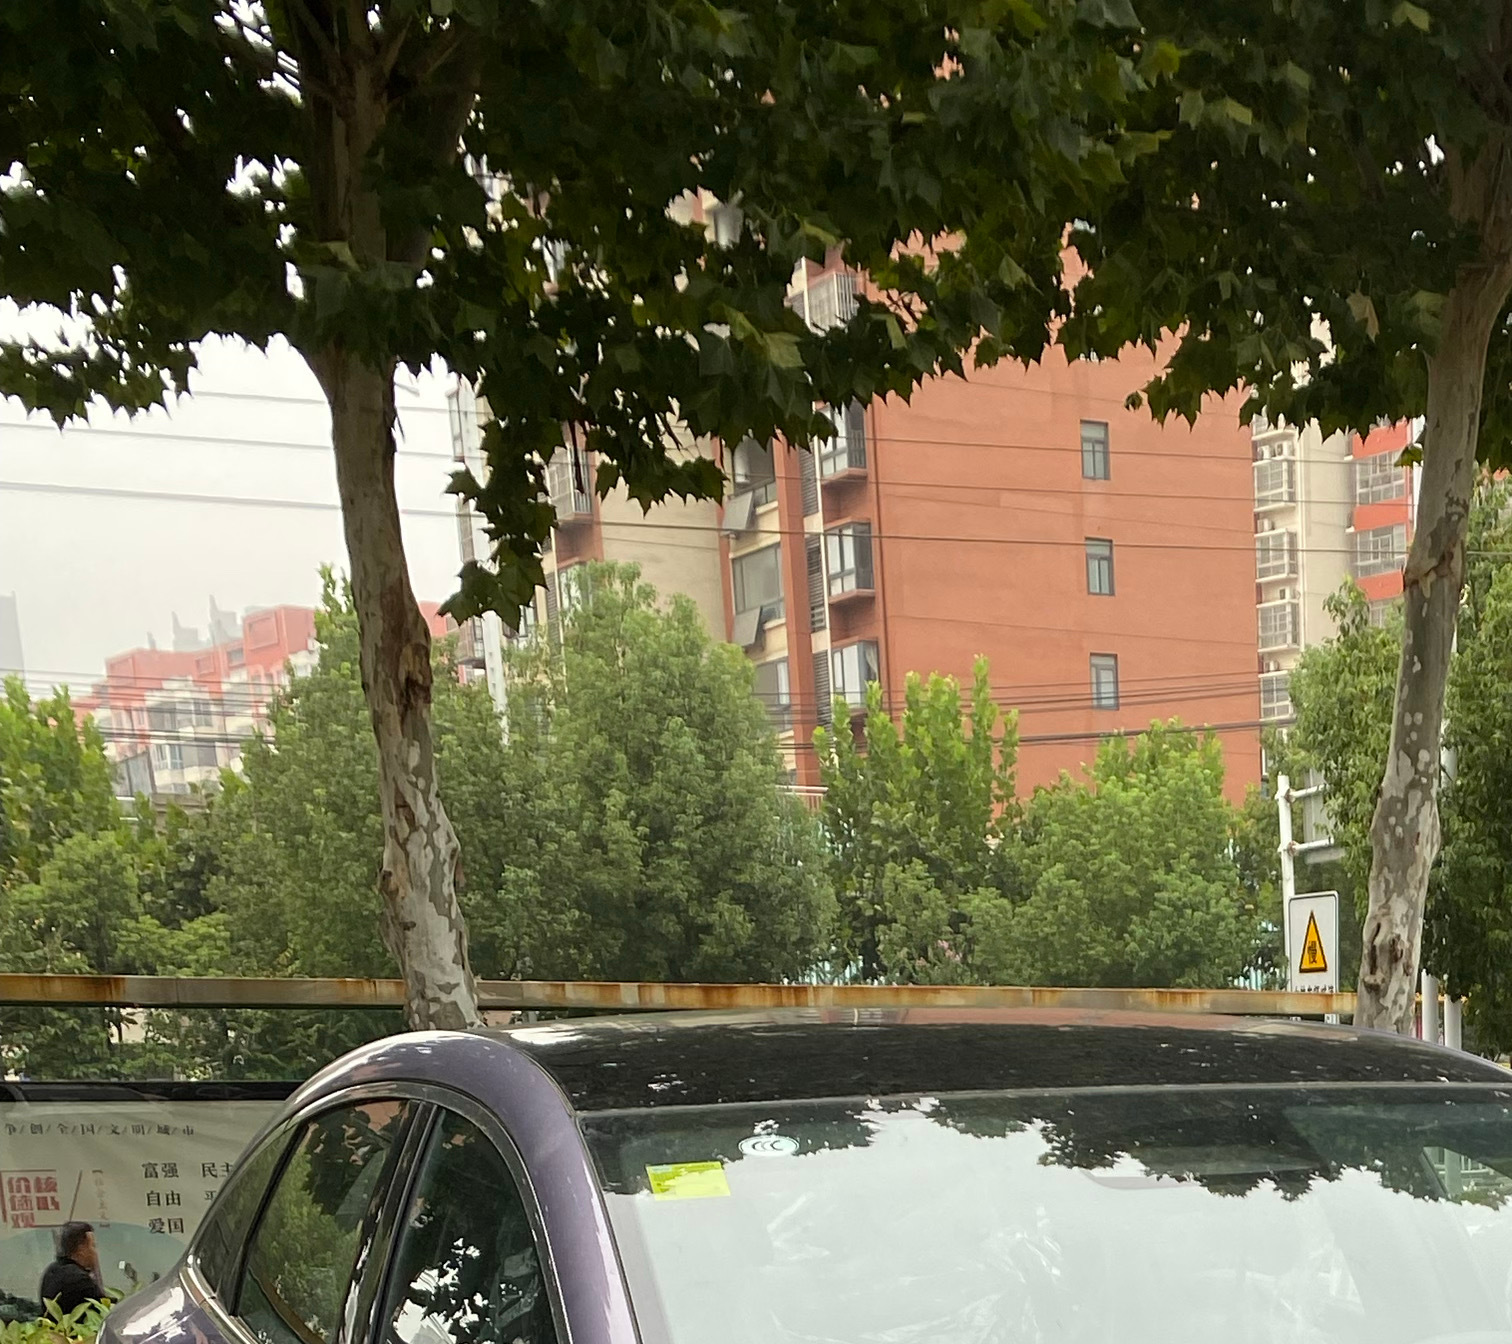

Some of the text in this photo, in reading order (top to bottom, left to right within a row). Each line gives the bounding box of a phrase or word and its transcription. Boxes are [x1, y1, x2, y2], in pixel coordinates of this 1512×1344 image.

[1307, 940, 1318, 964] 慢
[142, 1162, 179, 1178] 富强
[146, 1190, 181, 1206] 自由
[148, 1217, 184, 1234] 爱国
